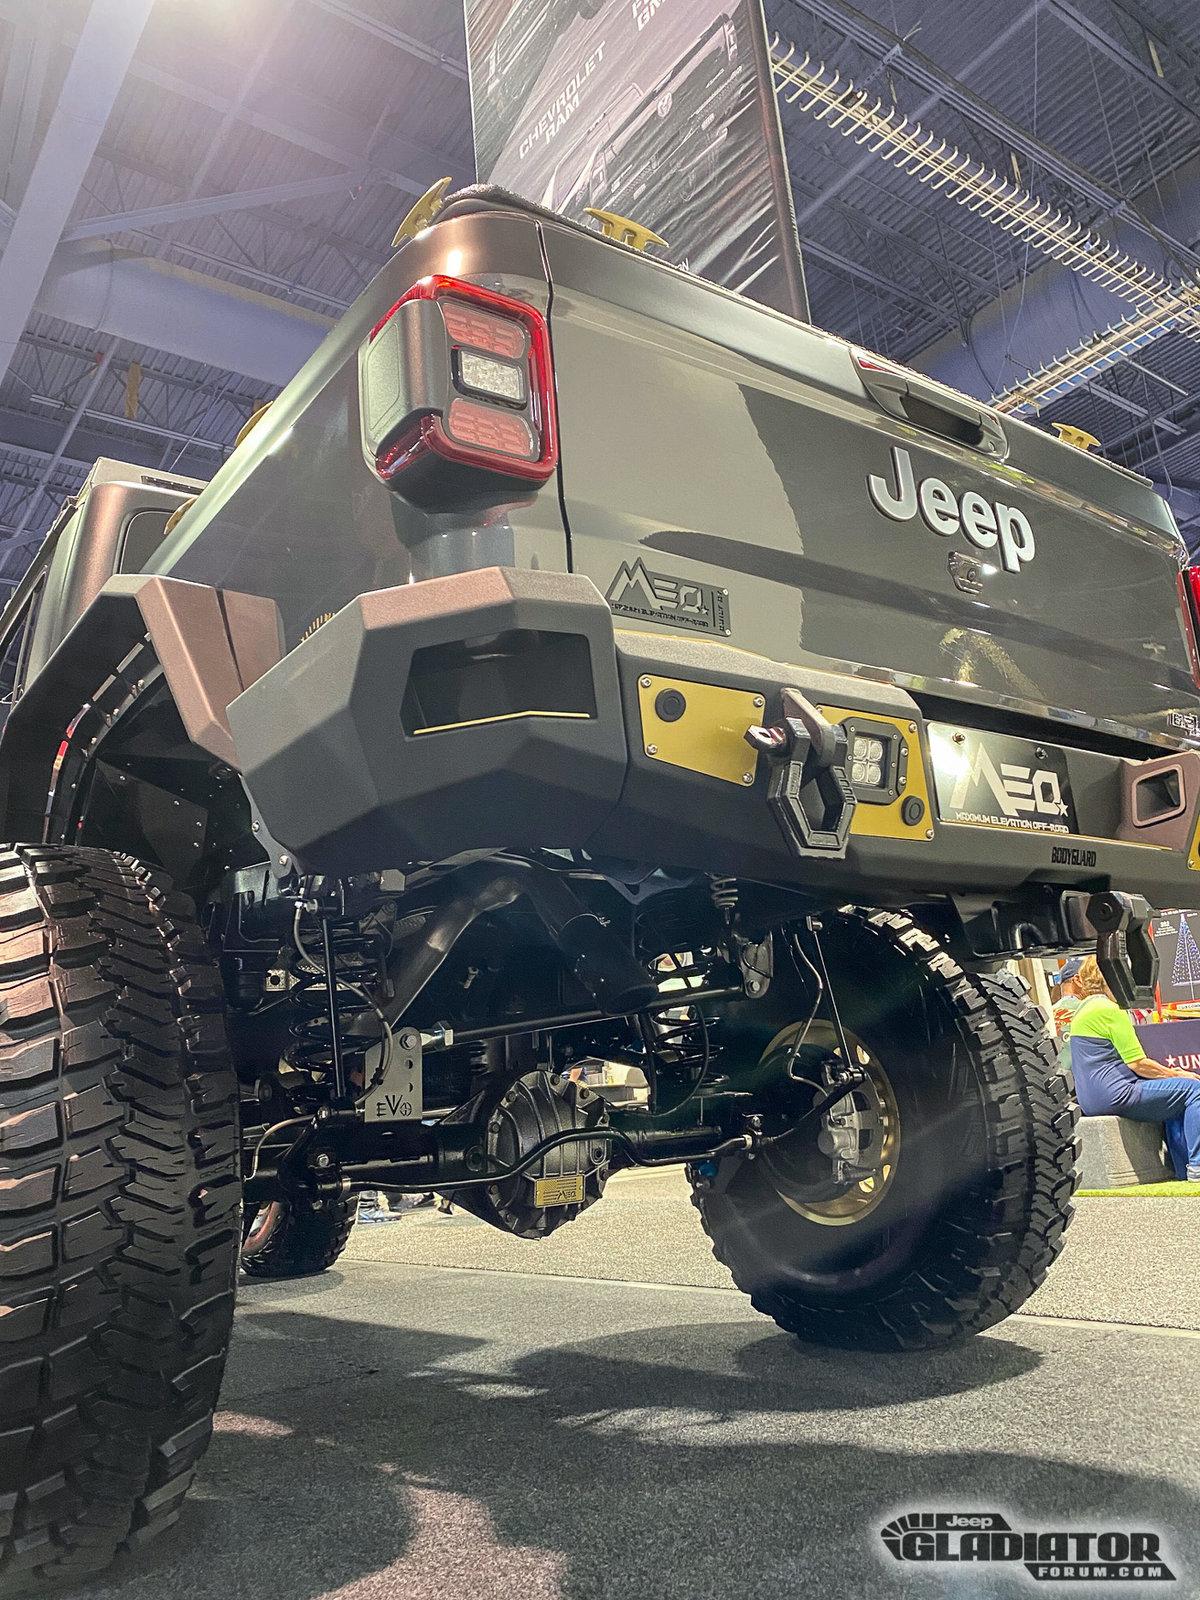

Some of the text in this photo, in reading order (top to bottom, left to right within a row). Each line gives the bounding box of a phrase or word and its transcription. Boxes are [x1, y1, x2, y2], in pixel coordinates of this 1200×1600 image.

[519, 41, 606, 159] CHEVROLET
[545, 92, 580, 144] RAM
[867, 446, 1036, 574] Jeep
[955, 811, 1070, 834] MAXIMUM ELEVATION OFF-ROAD
[1051, 846, 1097, 867] BODYGUARD
